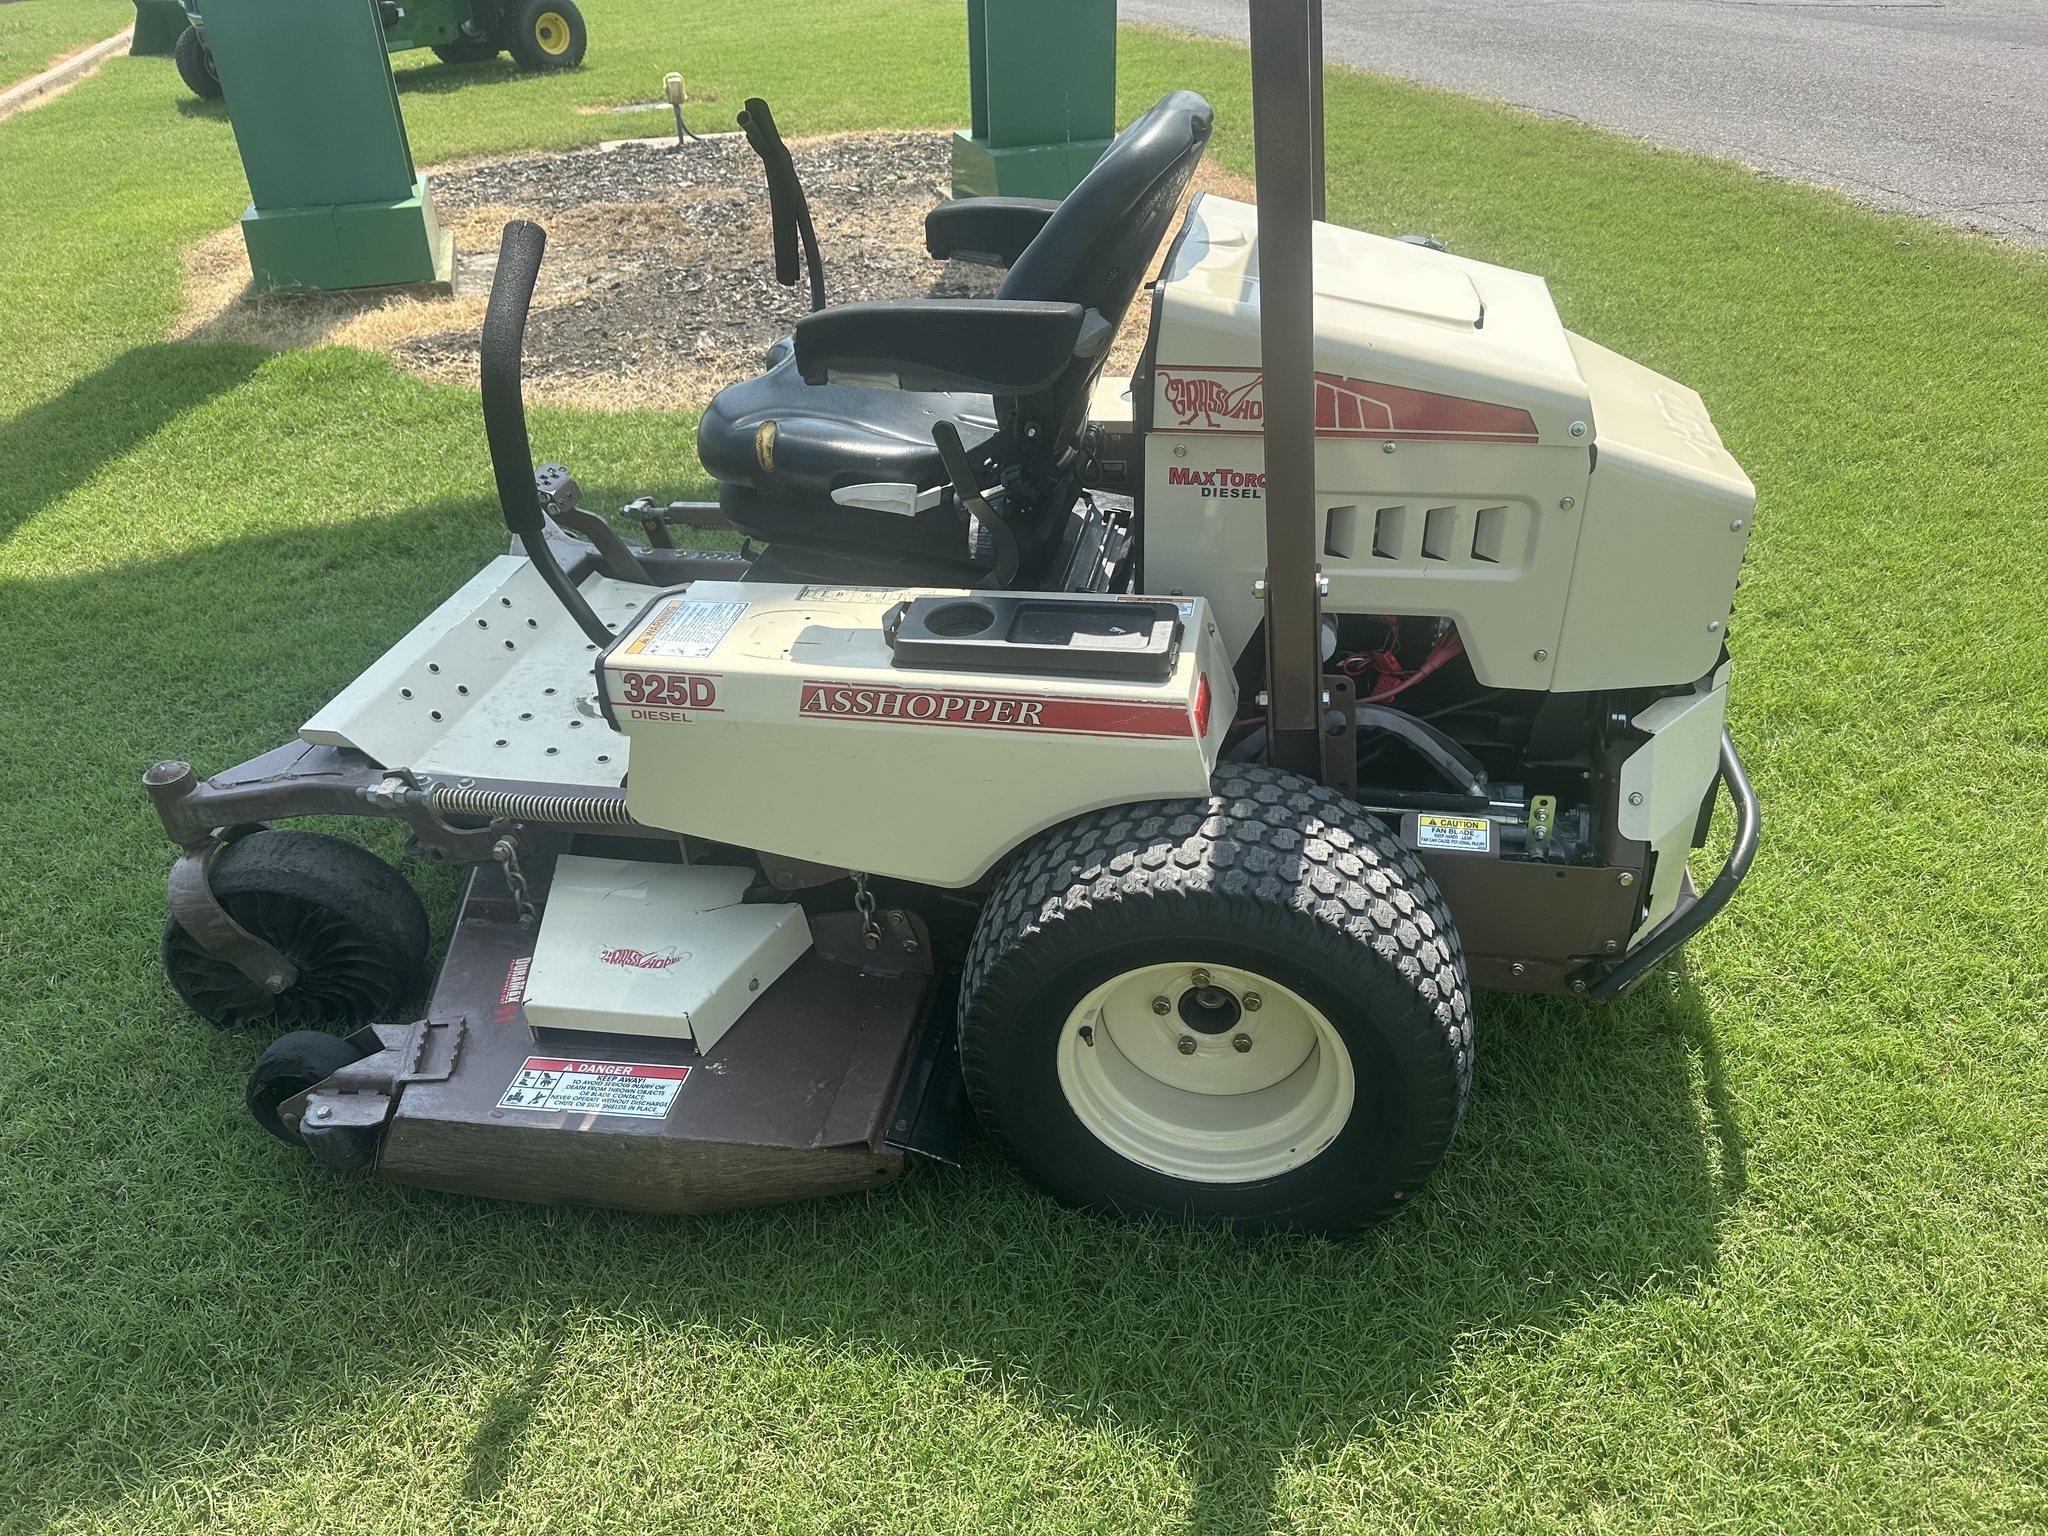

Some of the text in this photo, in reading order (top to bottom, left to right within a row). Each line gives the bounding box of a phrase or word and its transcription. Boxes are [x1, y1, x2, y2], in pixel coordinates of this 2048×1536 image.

[1165, 378, 1263, 421] GRASSHO
[1201, 487, 1261, 499] DIESEL
[644, 606, 677, 635] WARNING
[623, 673, 716, 707] 325D
[802, 688, 1045, 726] ASSHOPPER
[630, 709, 693, 723] DIESEL
[1440, 819, 1479, 829] CAUTION
[577, 1064, 633, 1075] DANGER
[601, 1097, 629, 1105] WITHOUT
